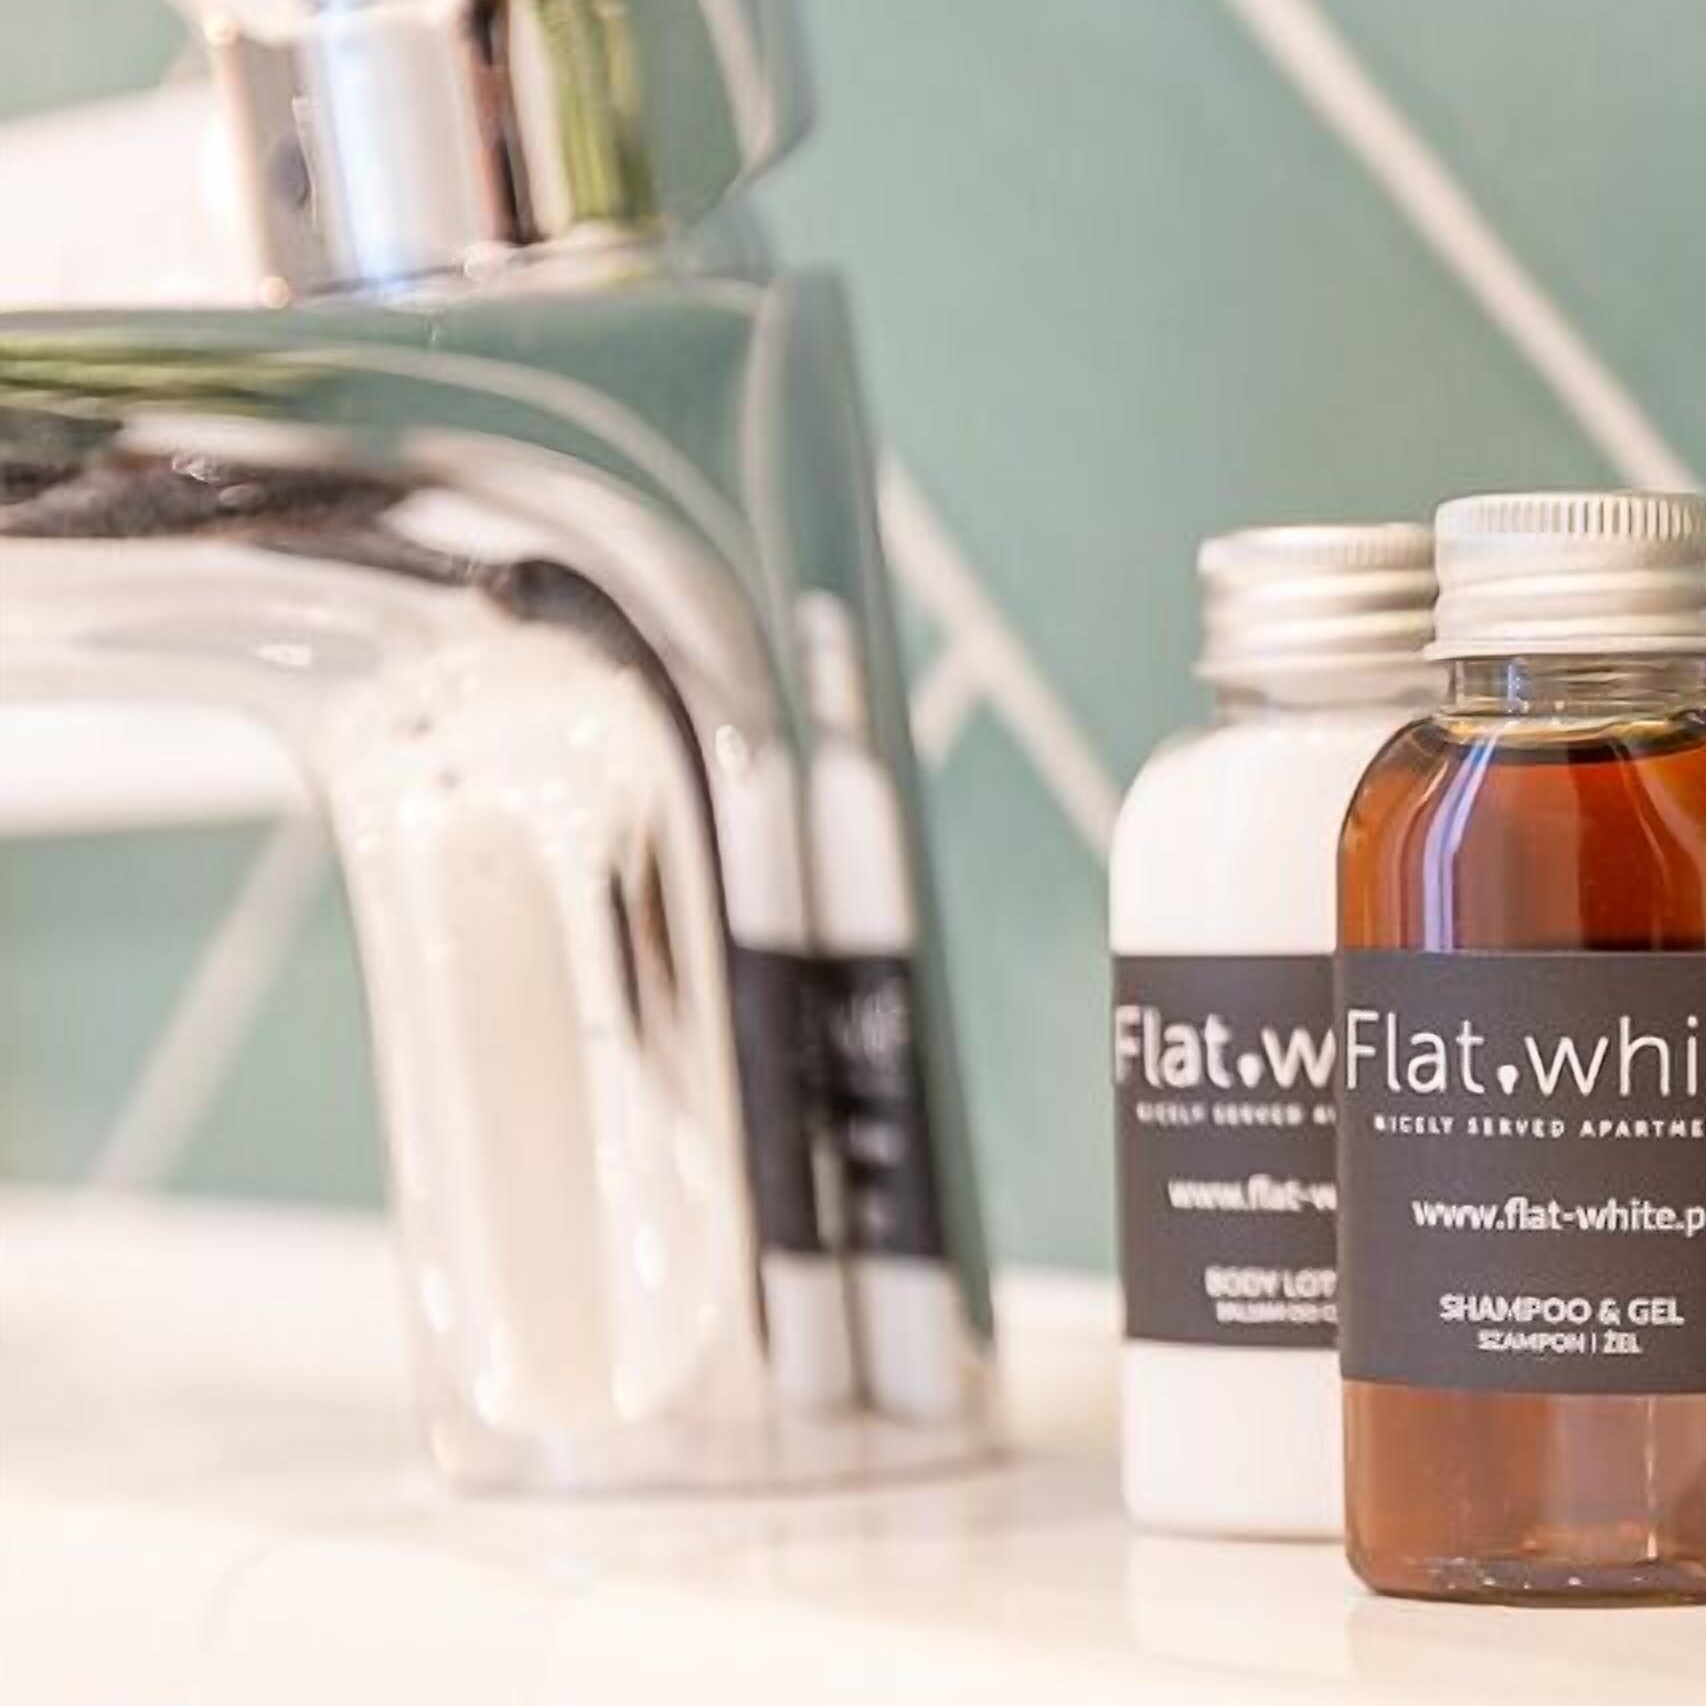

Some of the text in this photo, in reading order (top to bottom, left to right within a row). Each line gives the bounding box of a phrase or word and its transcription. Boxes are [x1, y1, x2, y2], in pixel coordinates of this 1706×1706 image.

[1374, 1113, 1455, 1134] NICELY
[1468, 1115, 1566, 1137] SERVED
[1439, 1293, 1686, 1326] SHAMPOO & GEL
